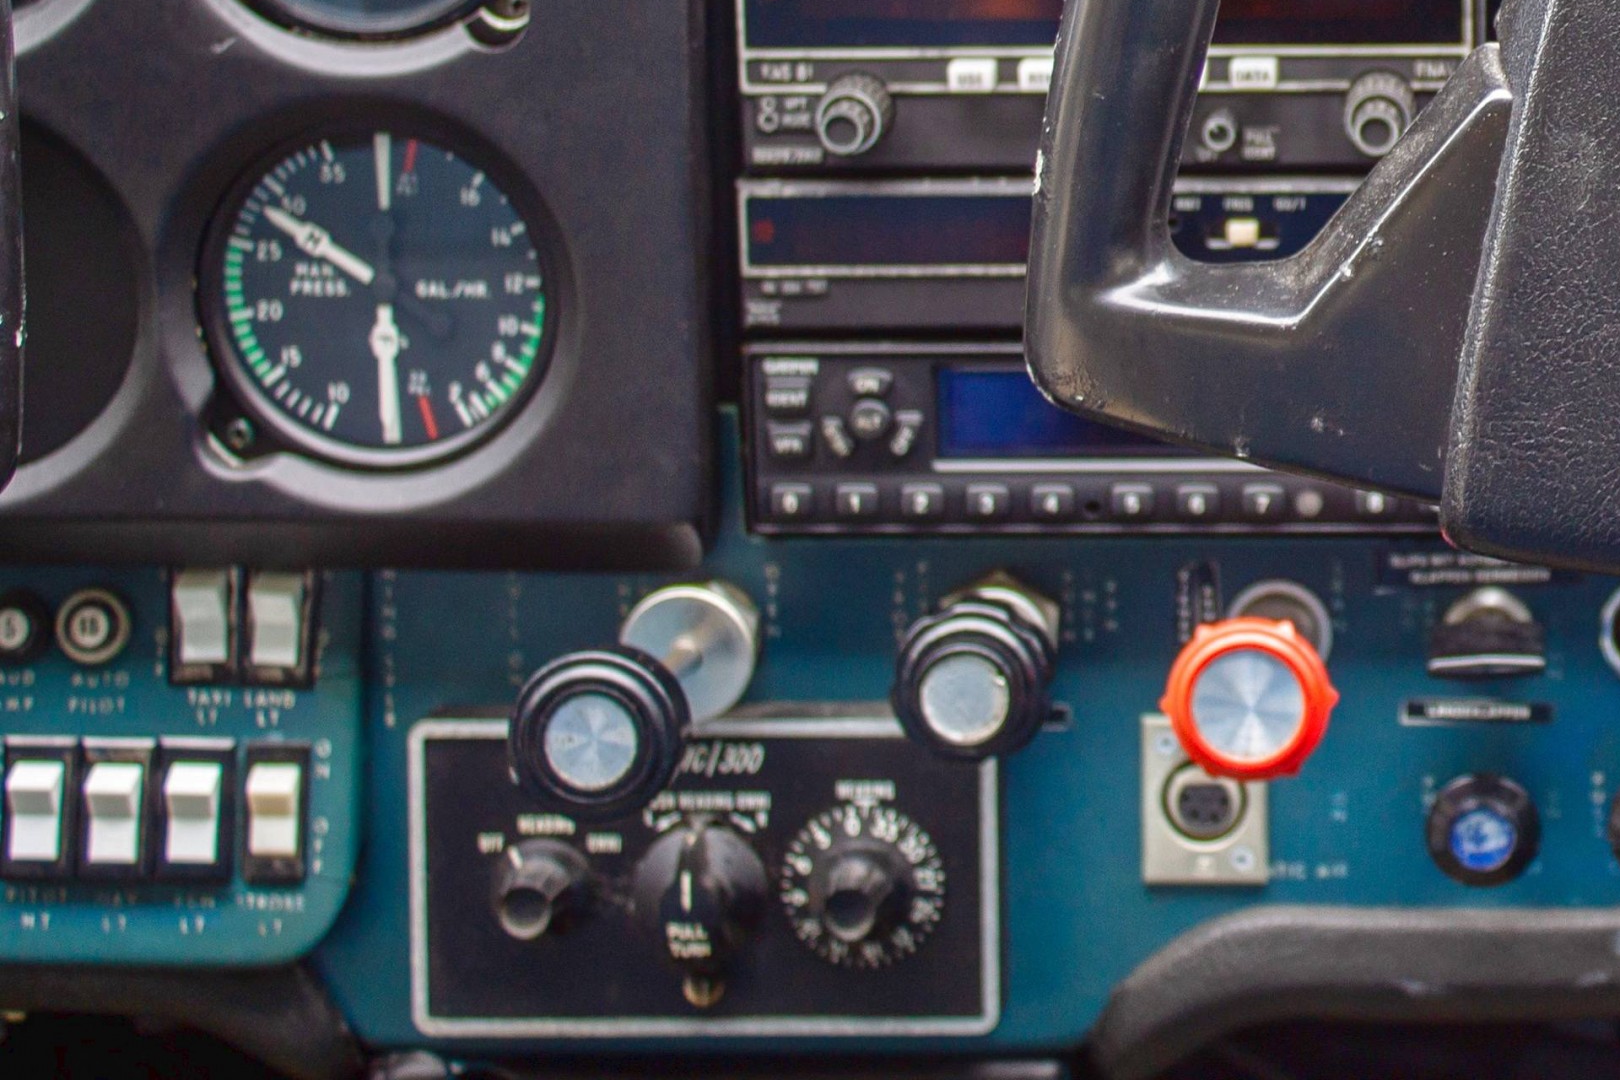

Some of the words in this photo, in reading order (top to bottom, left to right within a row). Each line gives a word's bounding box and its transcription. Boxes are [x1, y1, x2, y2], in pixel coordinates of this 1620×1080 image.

[256, 299, 284, 322] 20
[498, 314, 521, 338] 10
[281, 344, 303, 369] 15
[327, 380, 350, 405] 10
